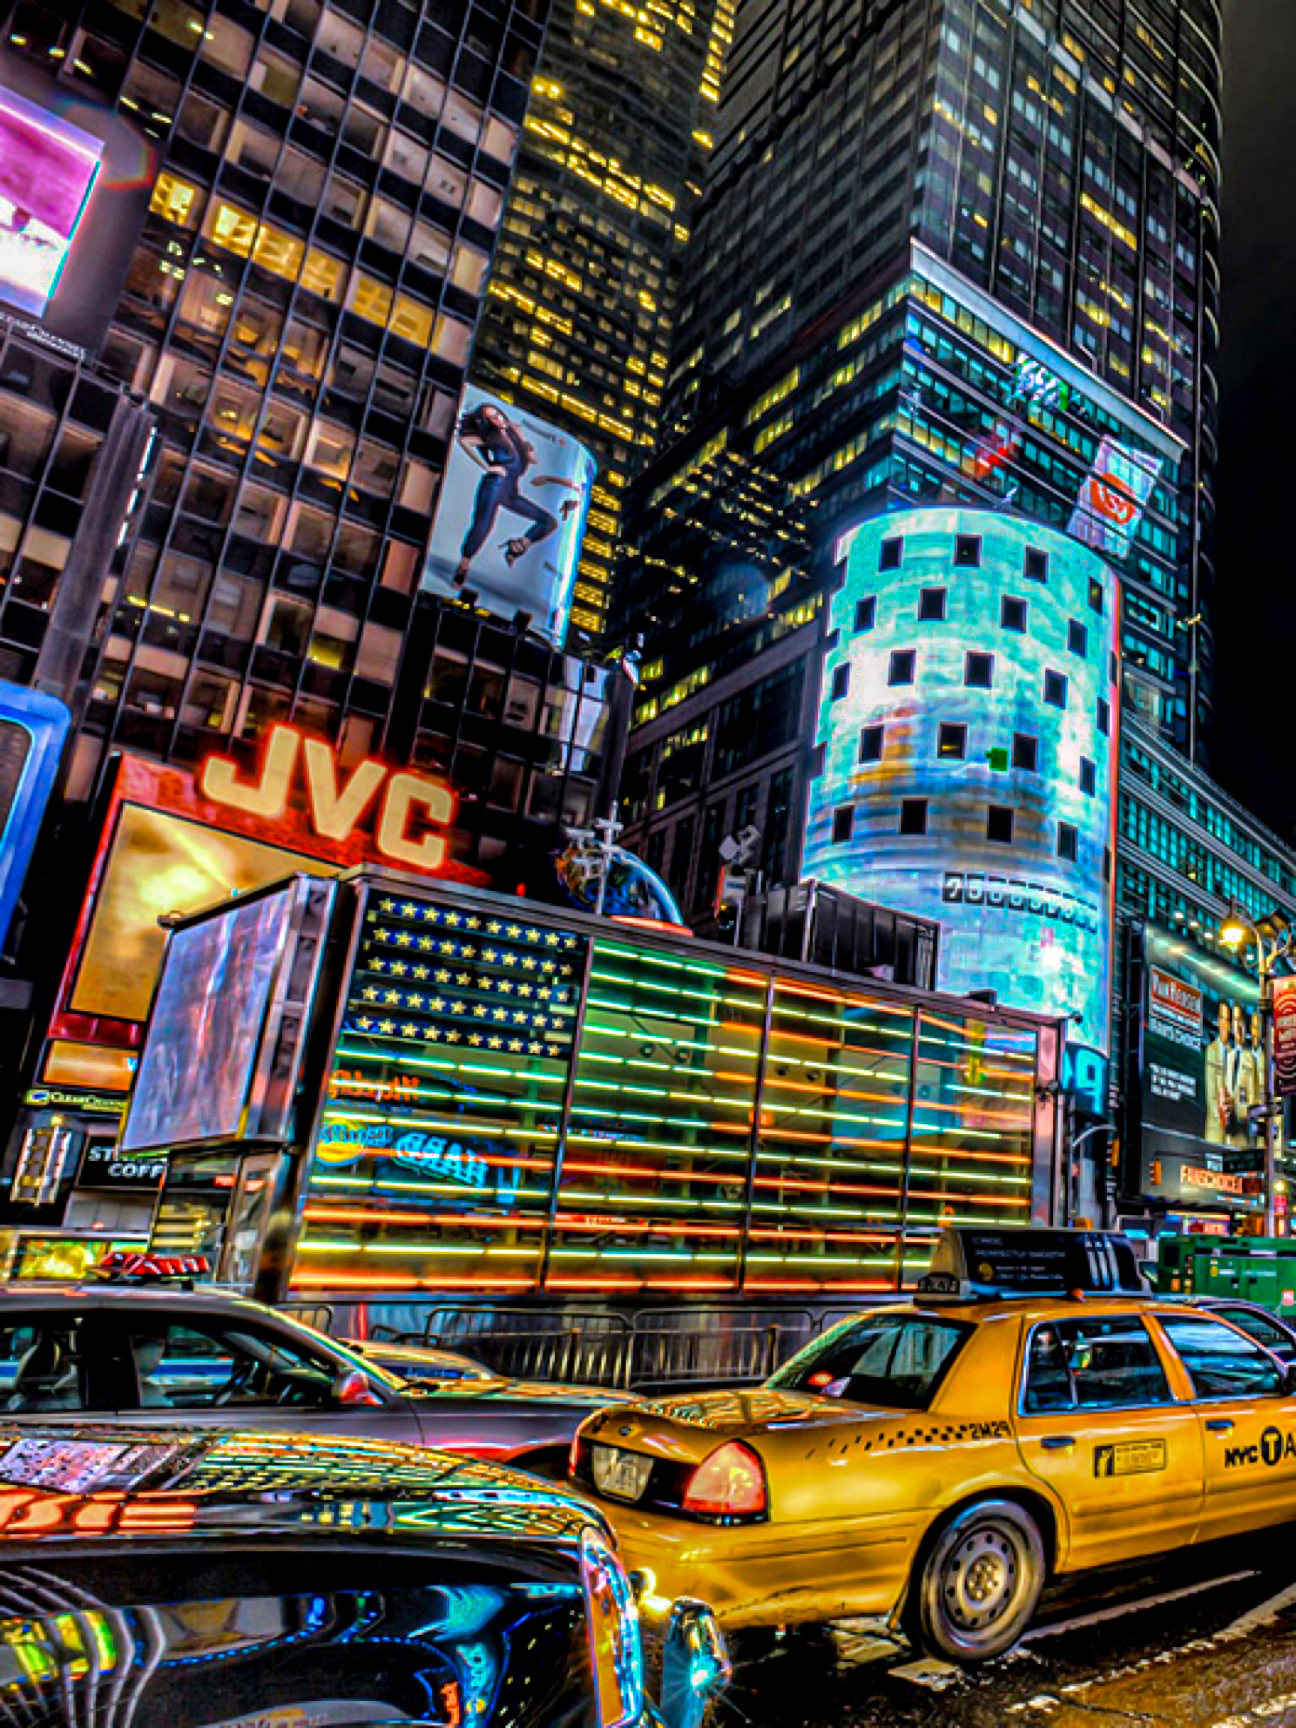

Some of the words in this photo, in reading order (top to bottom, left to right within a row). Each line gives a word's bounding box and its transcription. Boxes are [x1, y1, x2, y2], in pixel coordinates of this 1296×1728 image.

[201, 724, 455, 869] JVC
[107, 1162, 165, 1179] COFF
[1224, 1444, 1258, 1468] NYC
